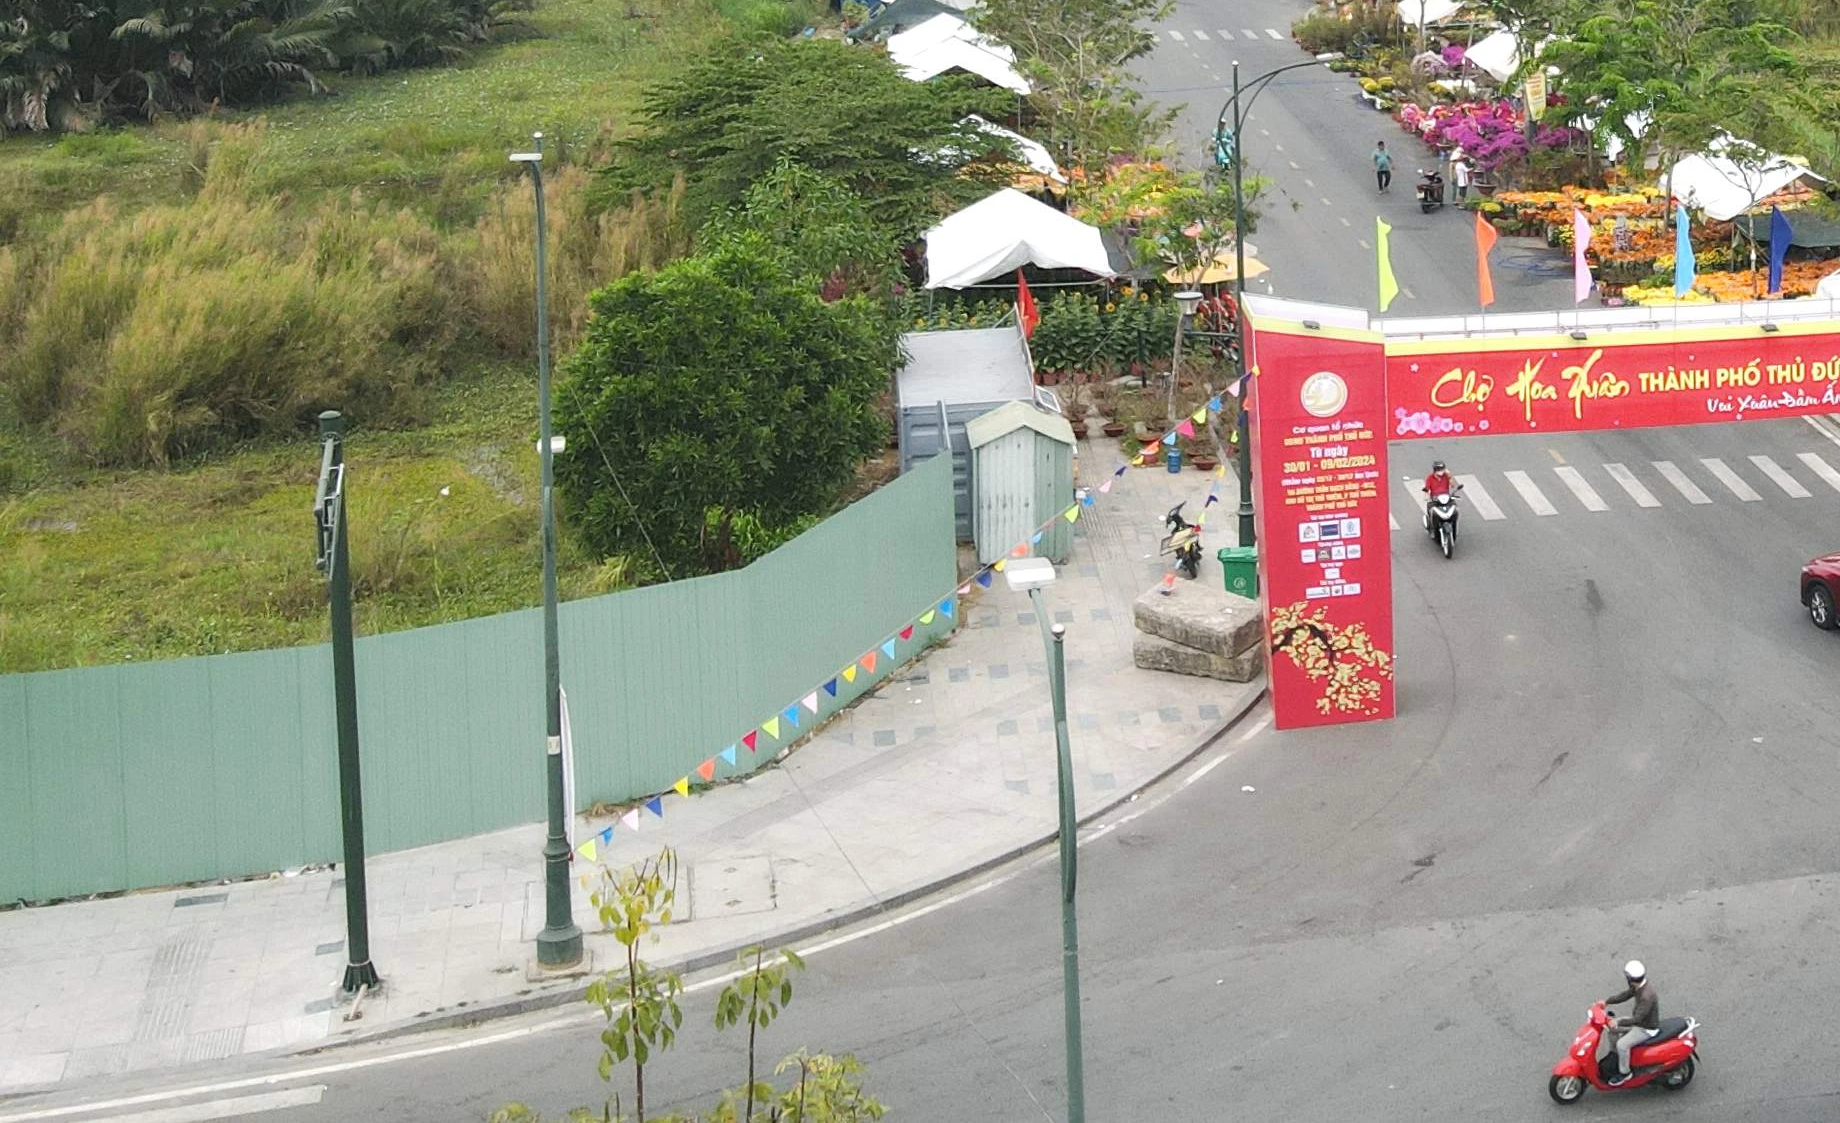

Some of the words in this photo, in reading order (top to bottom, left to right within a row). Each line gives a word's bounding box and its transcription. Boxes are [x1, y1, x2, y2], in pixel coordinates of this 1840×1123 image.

[1431, 367, 1494, 412] Chợ
[1504, 357, 1558, 422] Hoa
[1638, 366, 1710, 392] THÀNH
[1715, 357, 1761, 390] PHỐ
[1766, 357, 1805, 385] THỦ
